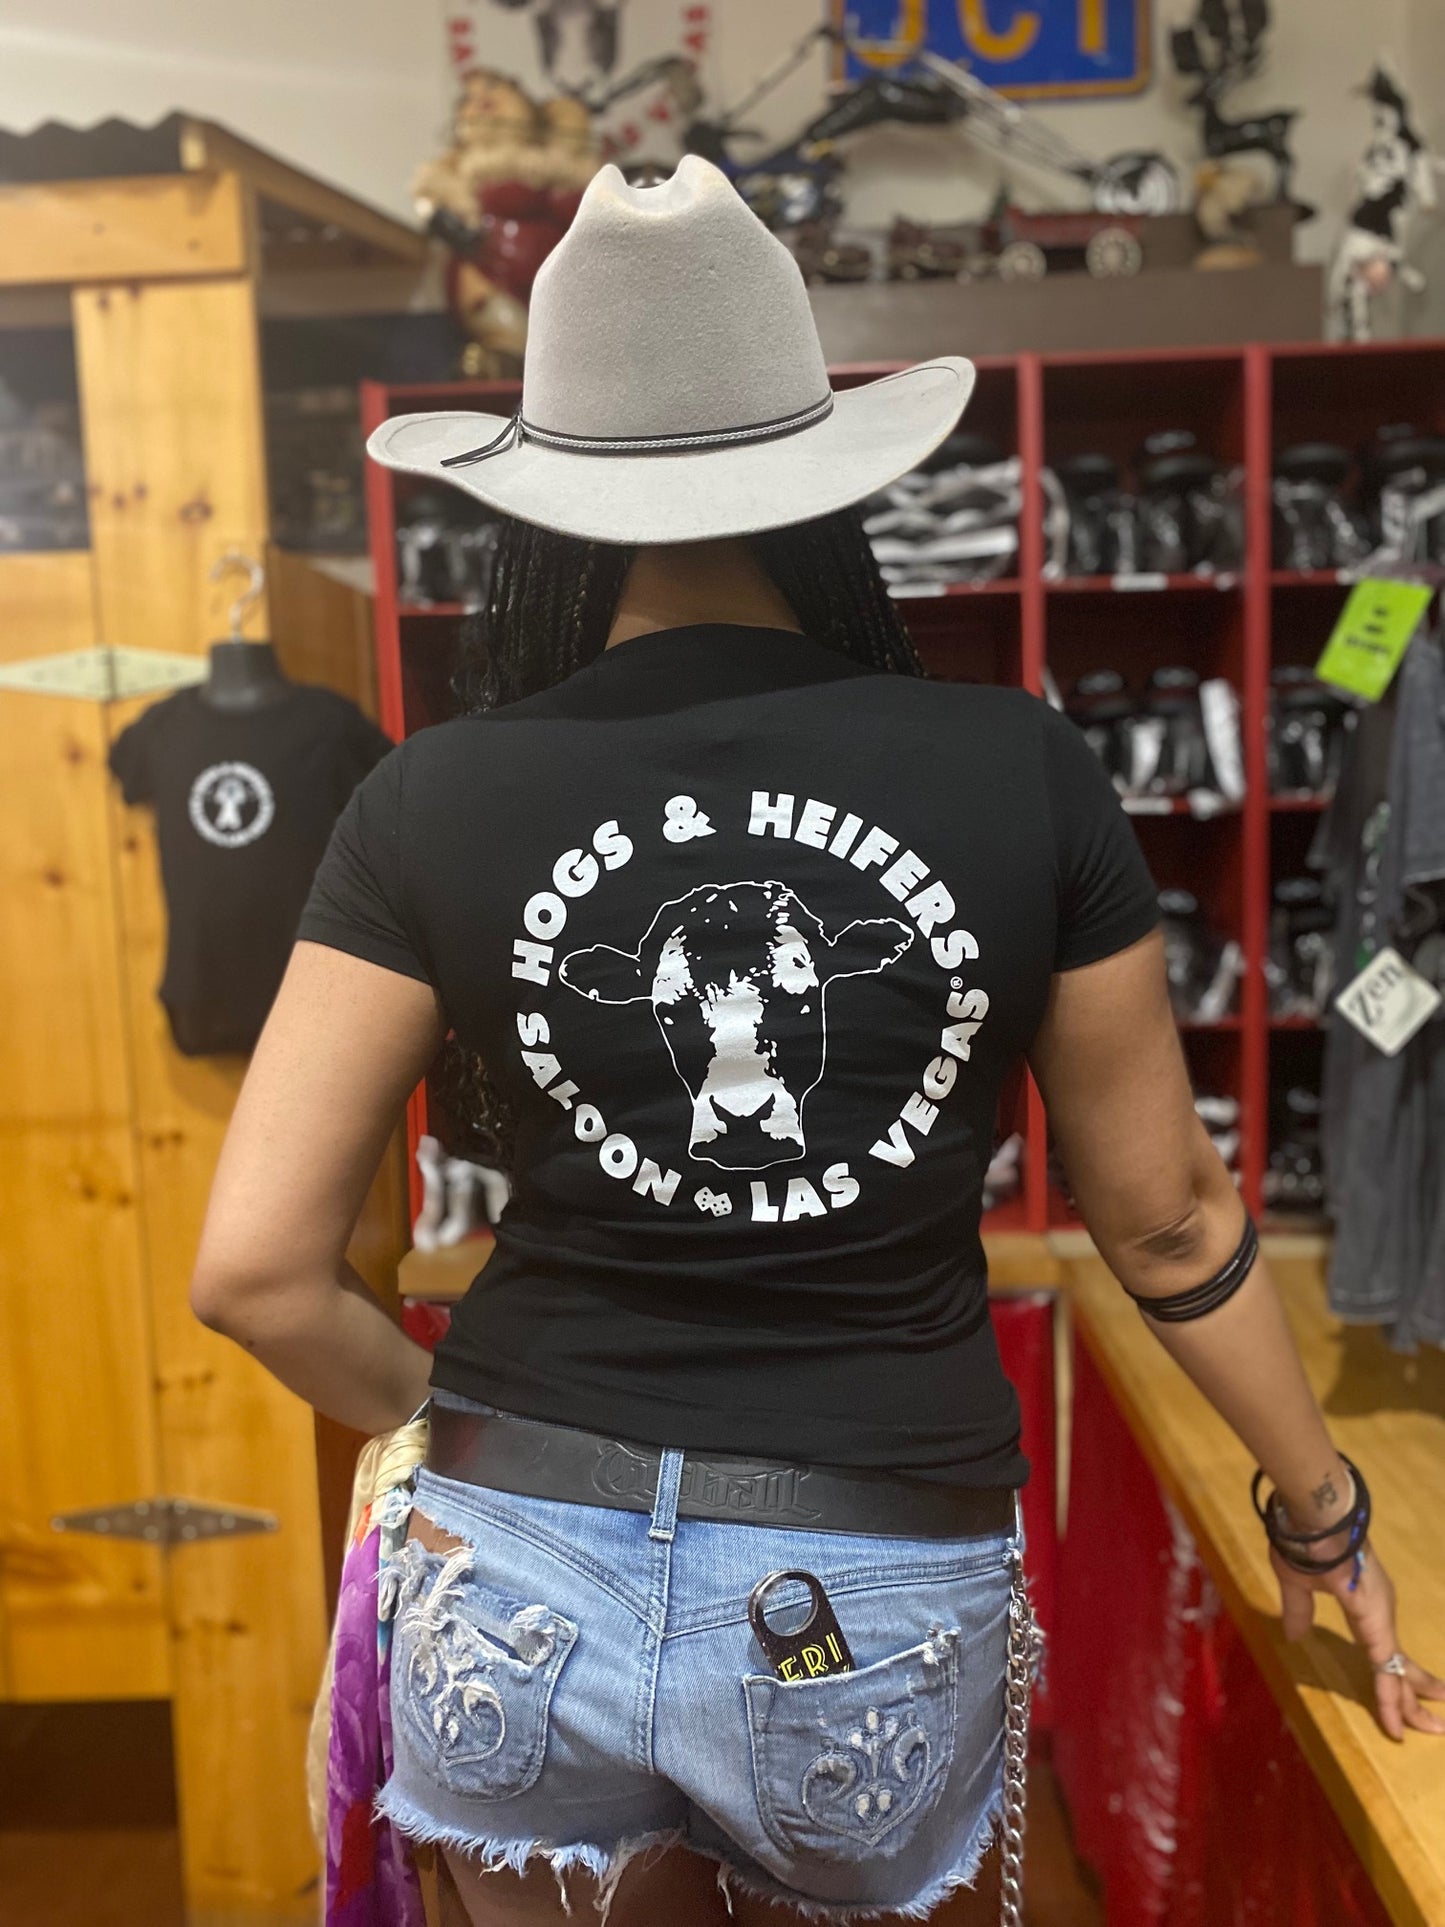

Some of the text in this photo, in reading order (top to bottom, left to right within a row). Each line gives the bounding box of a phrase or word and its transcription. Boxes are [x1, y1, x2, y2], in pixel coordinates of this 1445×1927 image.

[512, 819, 634, 987] HOGS
[662, 794, 717, 843] &
[1346, 962, 1402, 1027] Zen
[516, 988, 990, 1223] SALOON LAS VEGAS
